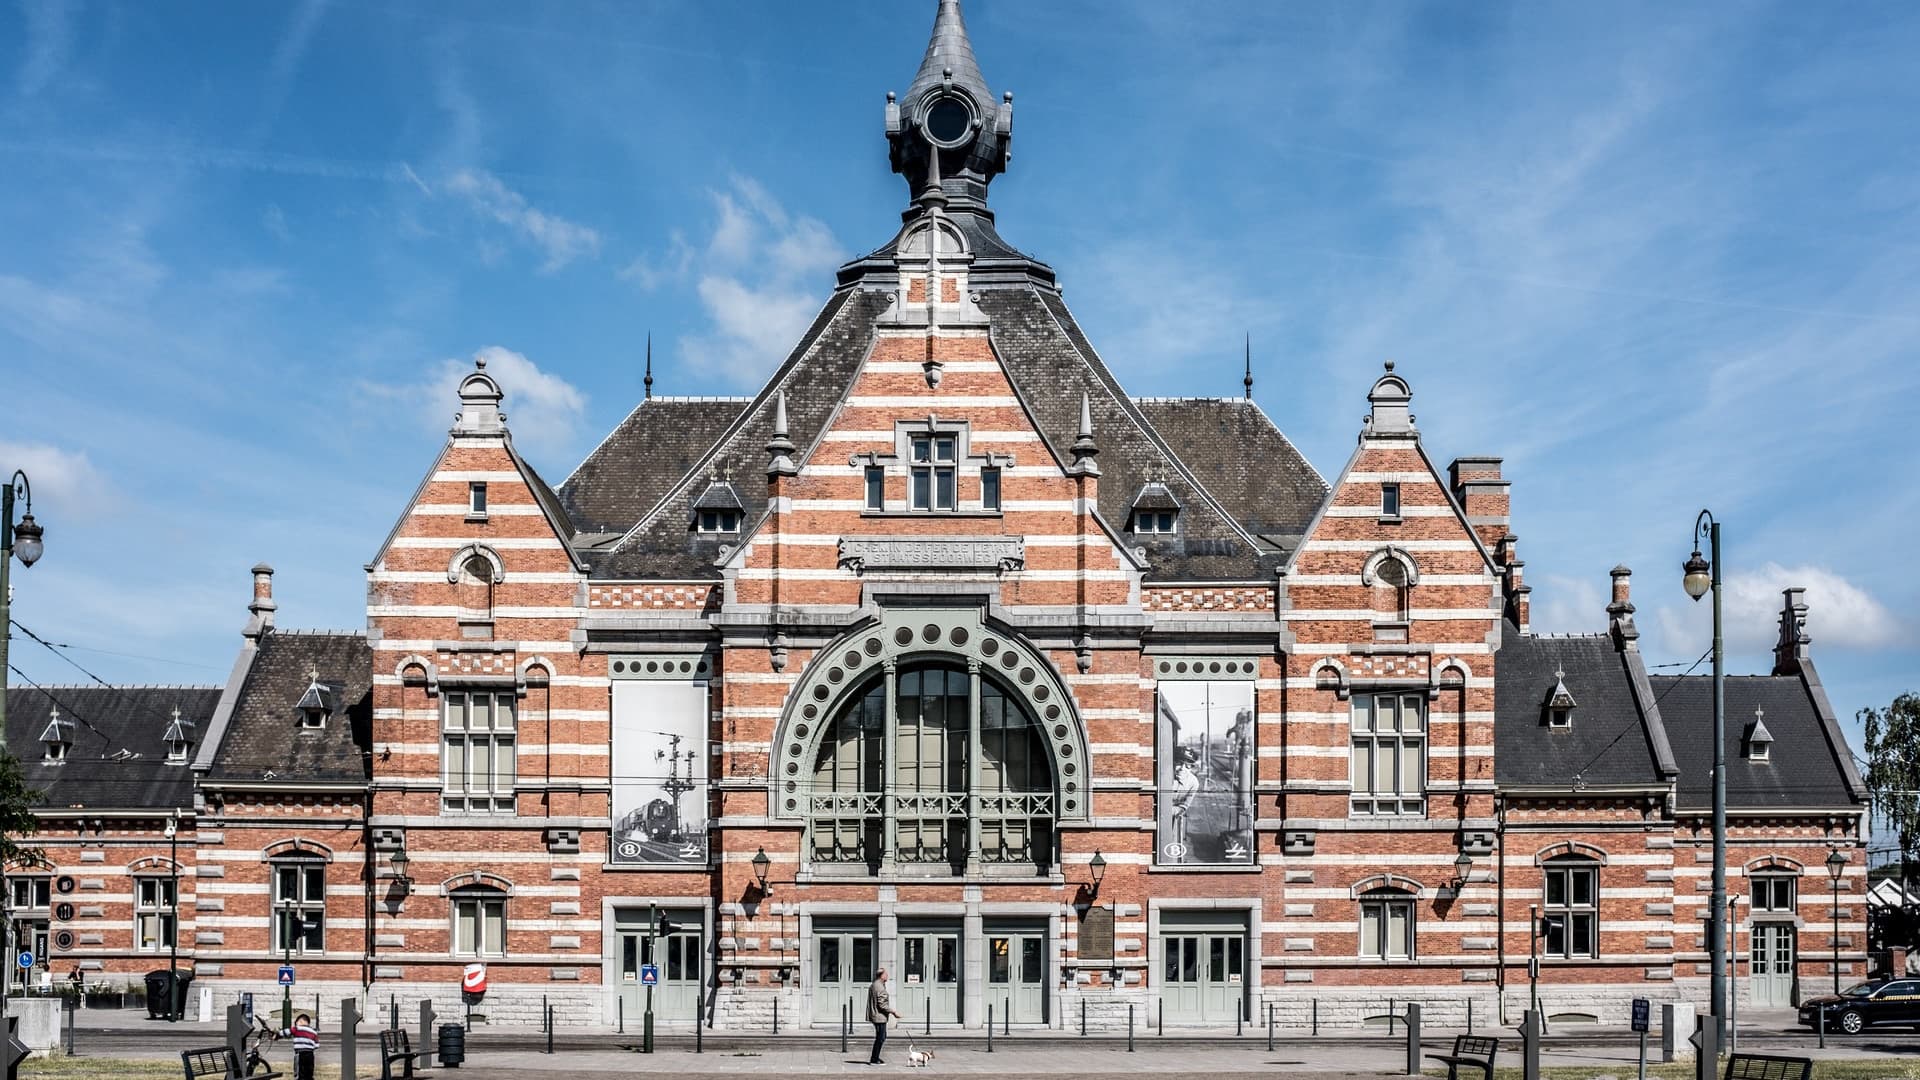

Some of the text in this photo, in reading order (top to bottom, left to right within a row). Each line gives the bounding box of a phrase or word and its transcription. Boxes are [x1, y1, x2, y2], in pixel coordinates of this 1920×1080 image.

[855, 543, 902, 553] CHEMIN
[904, 543, 921, 553] DE
[925, 543, 949, 553] FER
[952, 543, 969, 553] DE
